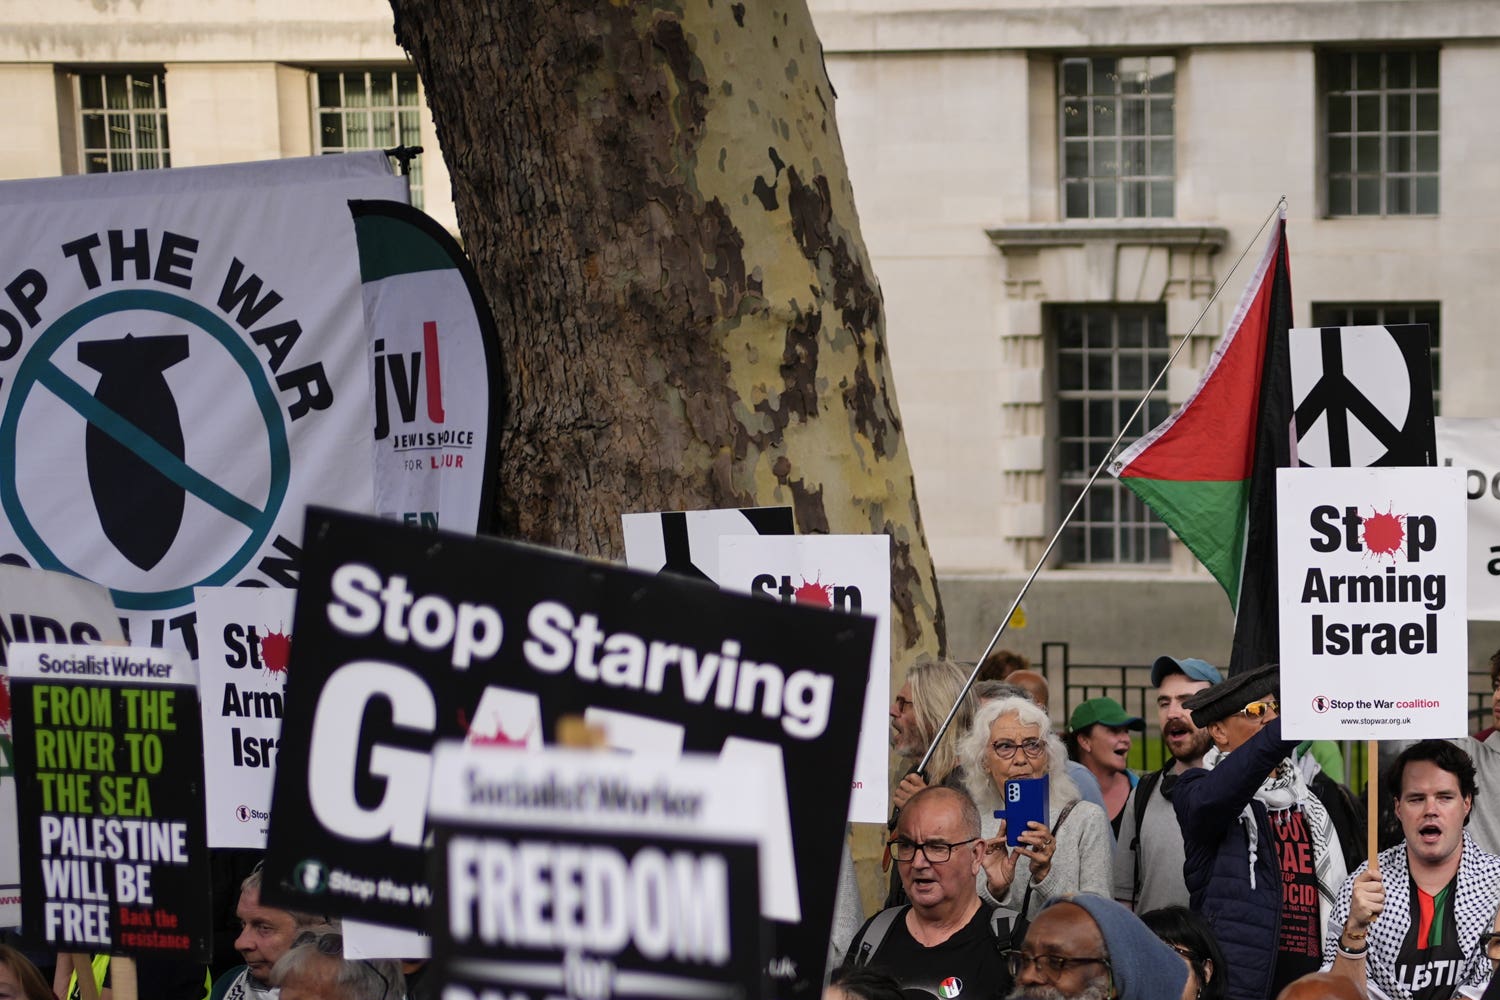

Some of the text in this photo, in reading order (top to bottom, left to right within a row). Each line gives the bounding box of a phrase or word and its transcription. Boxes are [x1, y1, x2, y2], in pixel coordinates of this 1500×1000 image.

[61, 228, 200, 290] THE
[216, 256, 334, 422] WAR
[374, 321, 445, 441] jvl
[1309, 503, 1438, 562] Stp
[1301, 566, 1447, 611] Arming
[325, 561, 504, 669] Stop
[522, 600, 835, 740] Starving
[1311, 613, 1439, 656] Israel
[38, 652, 173, 679] Socialist Worker
[32, 685, 176, 731] FROM THE
[1330, 698, 1440, 710] Stop the War coalition
[1340, 717, 1412, 727] www.stopwar.org.uk
[35, 729, 164, 774] RIVER TO
[36, 773, 152, 818] THE SEA
[40, 815, 189, 863] PALESTINE
[41, 858, 154, 904] WILL BE
[446, 834, 732, 965] FREEDOM
[44, 902, 179, 945] FREE Back the
[120, 930, 191, 950] resistance
